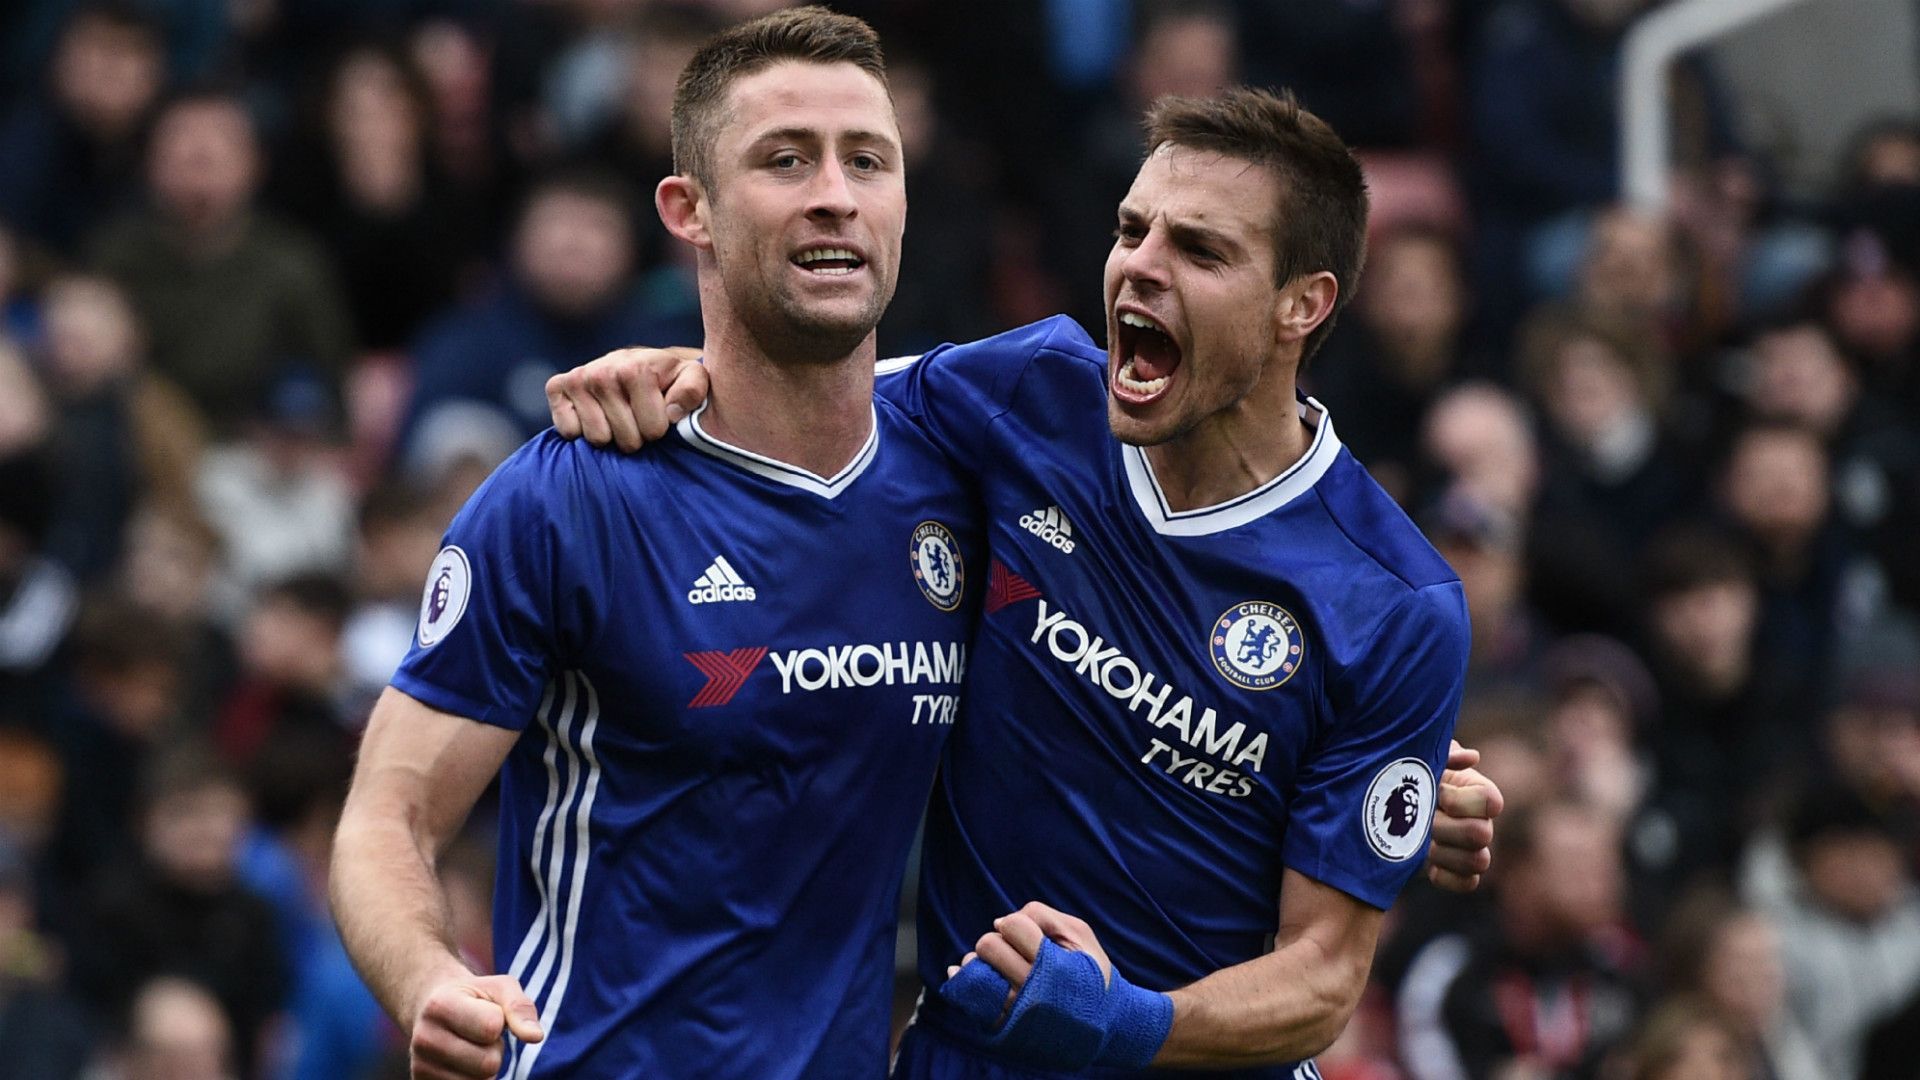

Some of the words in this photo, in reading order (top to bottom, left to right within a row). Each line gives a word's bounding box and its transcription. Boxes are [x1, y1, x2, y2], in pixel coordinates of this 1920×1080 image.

[915, 525, 949, 545] CHELSEA
[1019, 514, 1075, 554] adidas
[687, 582, 756, 604] adidas
[1239, 604, 1295, 634] CHELSEA
[1031, 599, 1268, 772] YOKOHAMA
[1218, 656, 1251, 684] FOOTBALL
[1254, 676, 1276, 685] CLUB
[1141, 738, 1260, 798] TYRES
